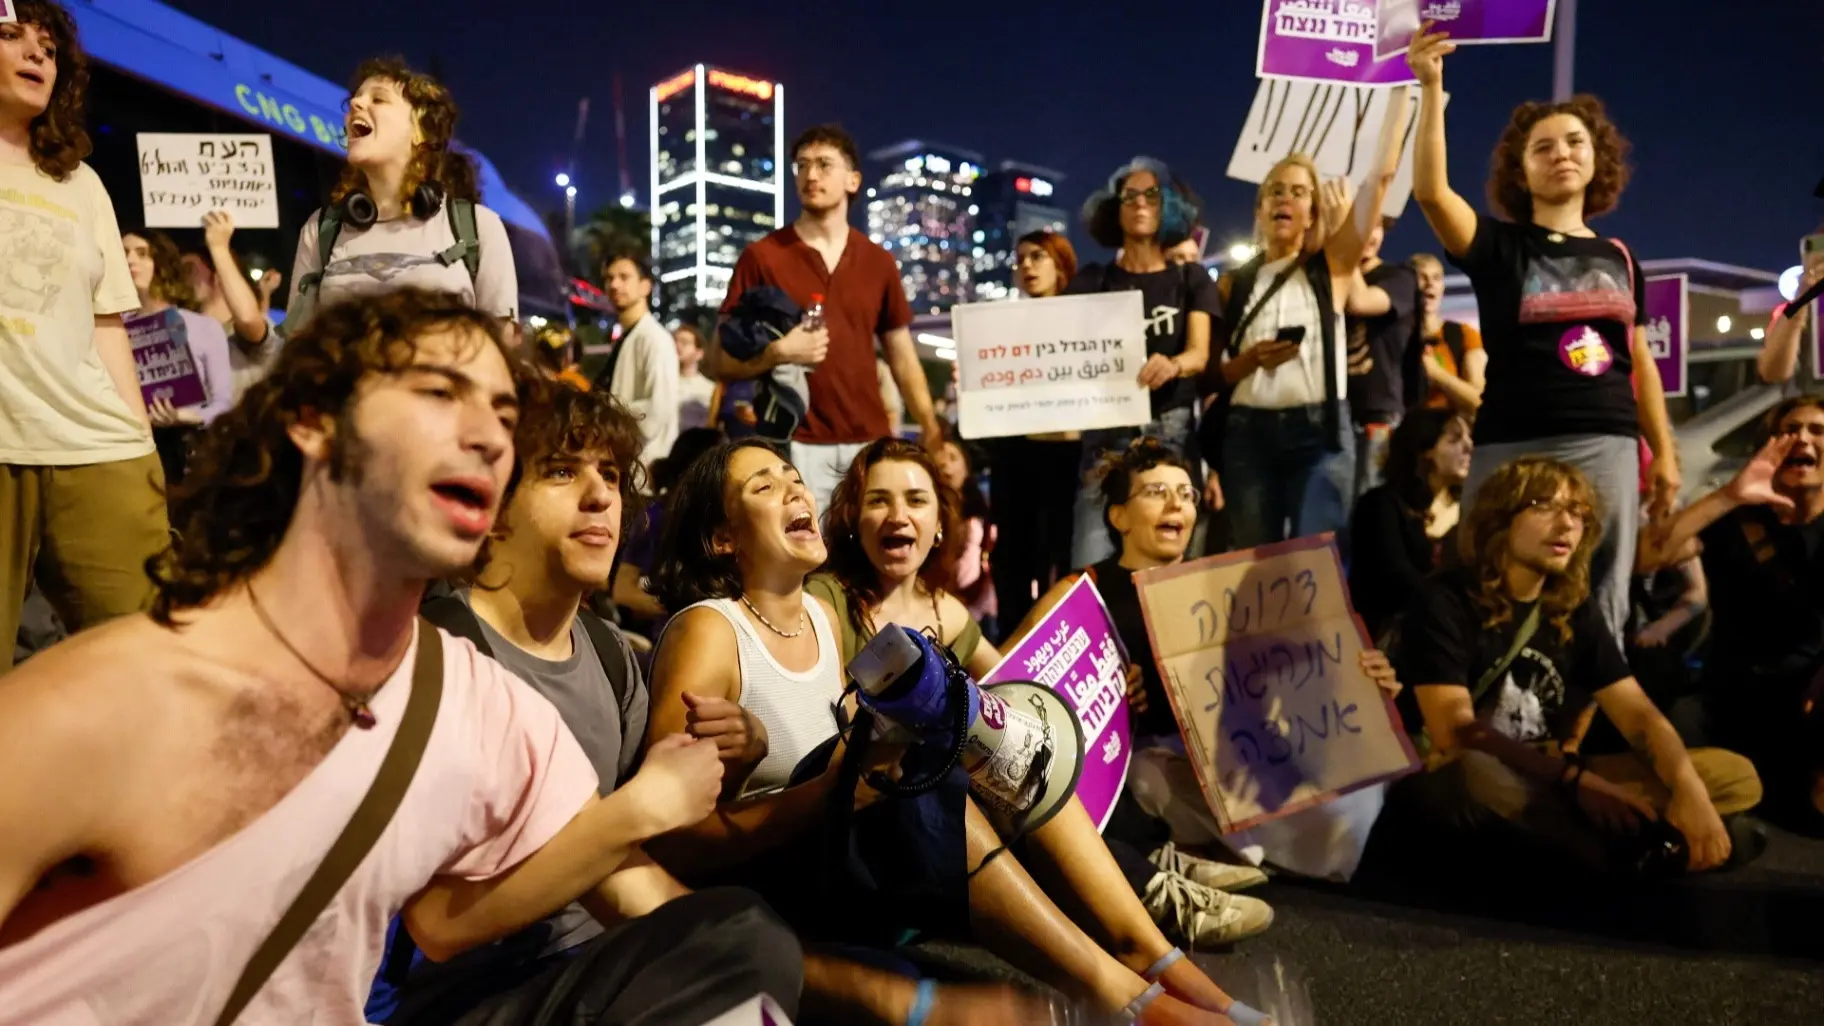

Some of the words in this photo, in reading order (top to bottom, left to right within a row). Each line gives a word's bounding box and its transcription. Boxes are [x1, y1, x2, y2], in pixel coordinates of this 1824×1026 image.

[1282, 15, 1326, 33] ננצח
[234, 83, 306, 133] CNG
[198, 140, 259, 160] העם
[978, 345, 1006, 360] לדם
[1012, 344, 1031, 357] דם
[1035, 343, 1055, 358] בין
[1060, 340, 1097, 353] הבדל
[1101, 339, 1123, 353] אין
[1047, 365, 1073, 382] بين
[1077, 359, 1110, 380] فرق
[1113, 357, 1124, 373] لا
[981, 370, 1015, 388] ودم
[1019, 368, 1043, 385] دم
[1190, 569, 1318, 643] דרושה
[1049, 619, 1070, 647] عرب
[1023, 641, 1055, 674] ويهود
[1061, 631, 1087, 664] ערבים
[1089, 631, 1120, 680] فقط
[1204, 632, 1342, 712] מנהיגות
[1081, 685, 1115, 730] ביחד
[1230, 699, 1362, 767] אמיצה
